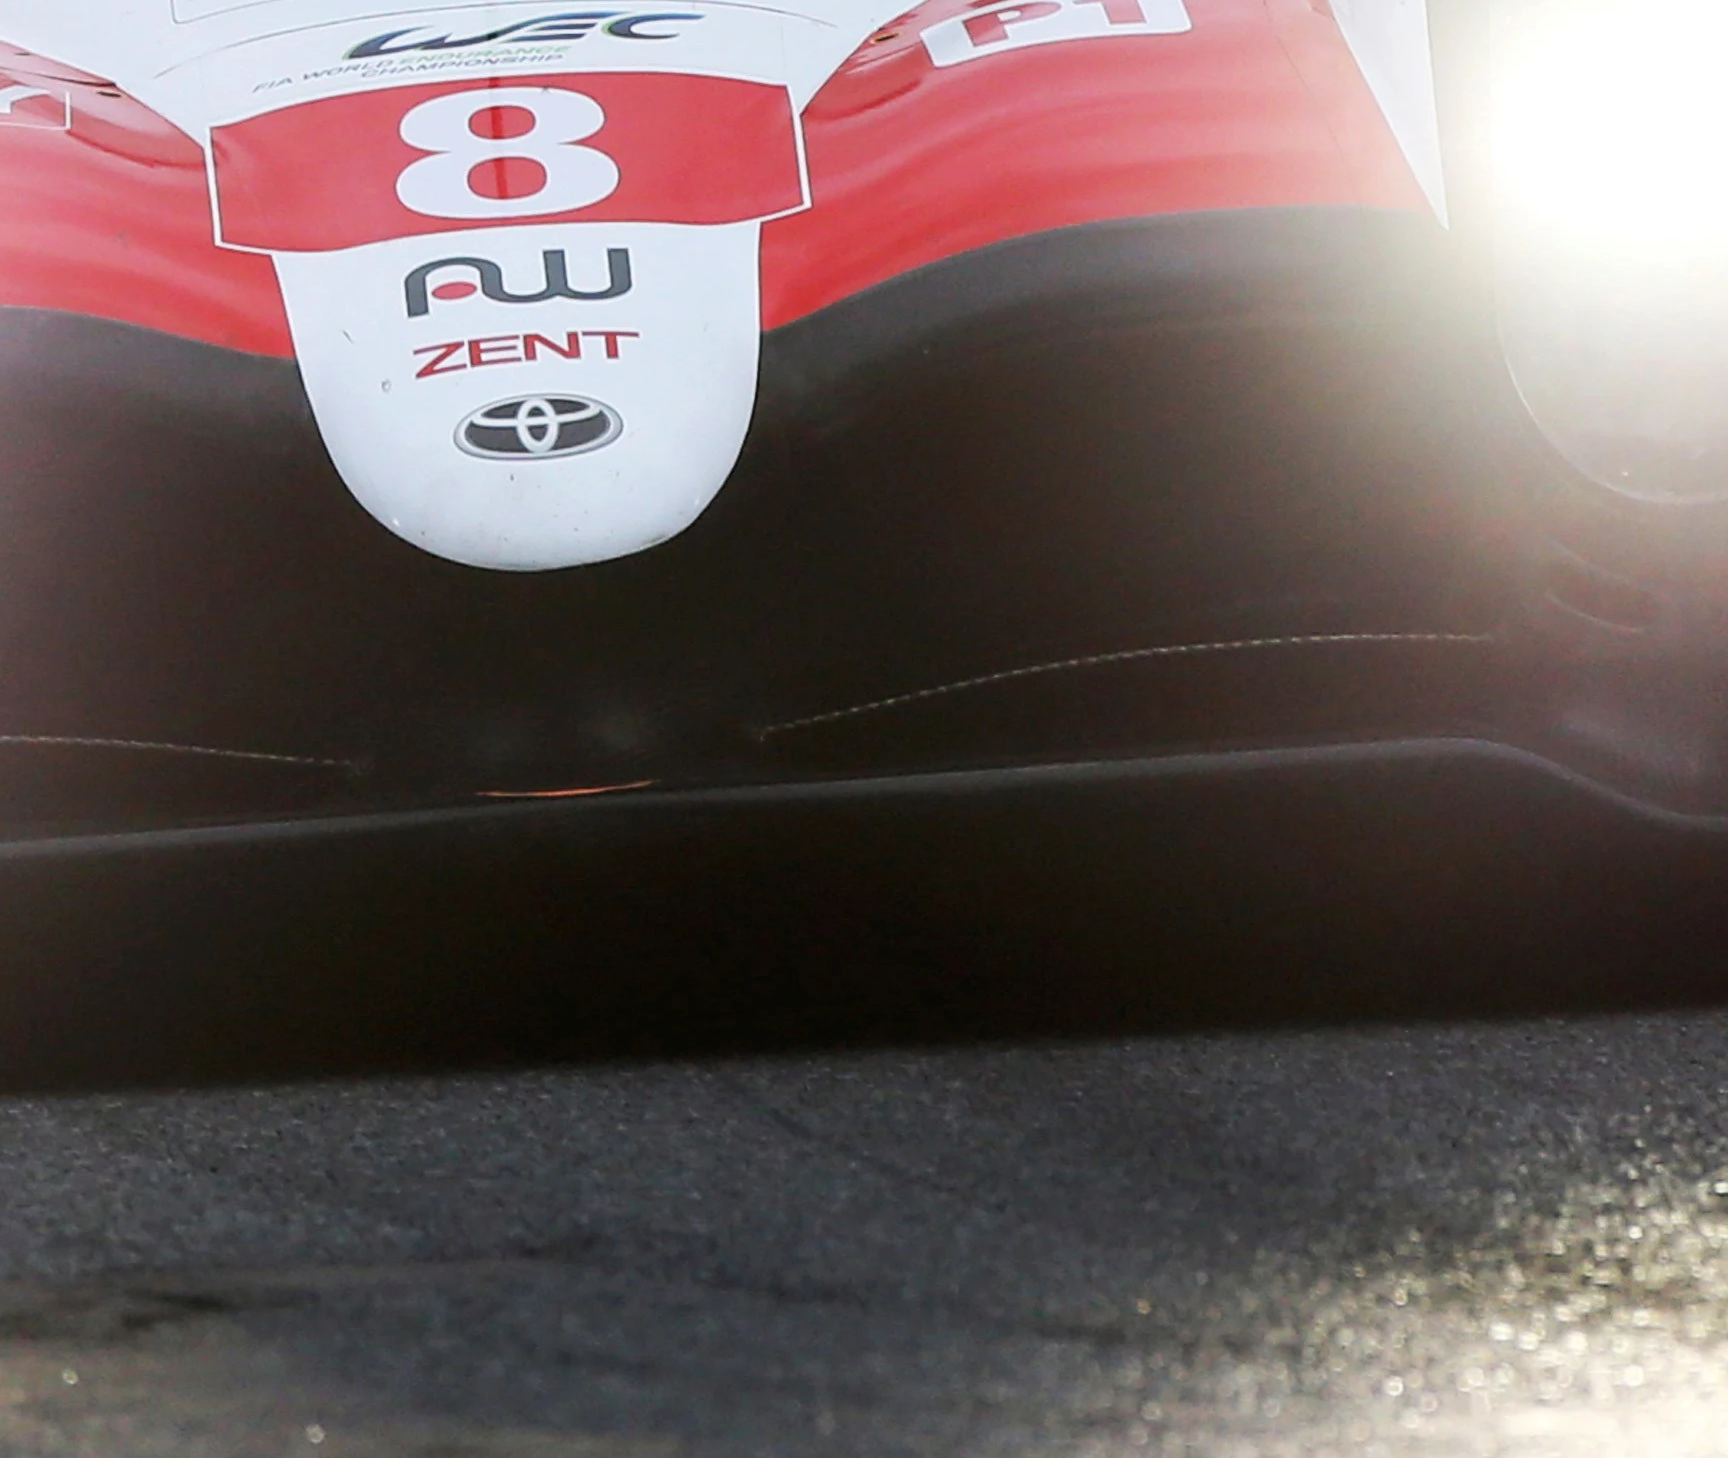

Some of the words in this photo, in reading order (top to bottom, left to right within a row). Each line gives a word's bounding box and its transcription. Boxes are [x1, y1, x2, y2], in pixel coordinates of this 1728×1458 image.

[344, 11, 705, 60] WEC
[252, 75, 293, 94] FIA
[302, 59, 394, 82] WORLD
[398, 46, 572, 65] ENDURANCE
[360, 54, 566, 79] CHAMPIONSHIP
[396, 87, 620, 219] 8
[414, 331, 639, 379] ZENT
